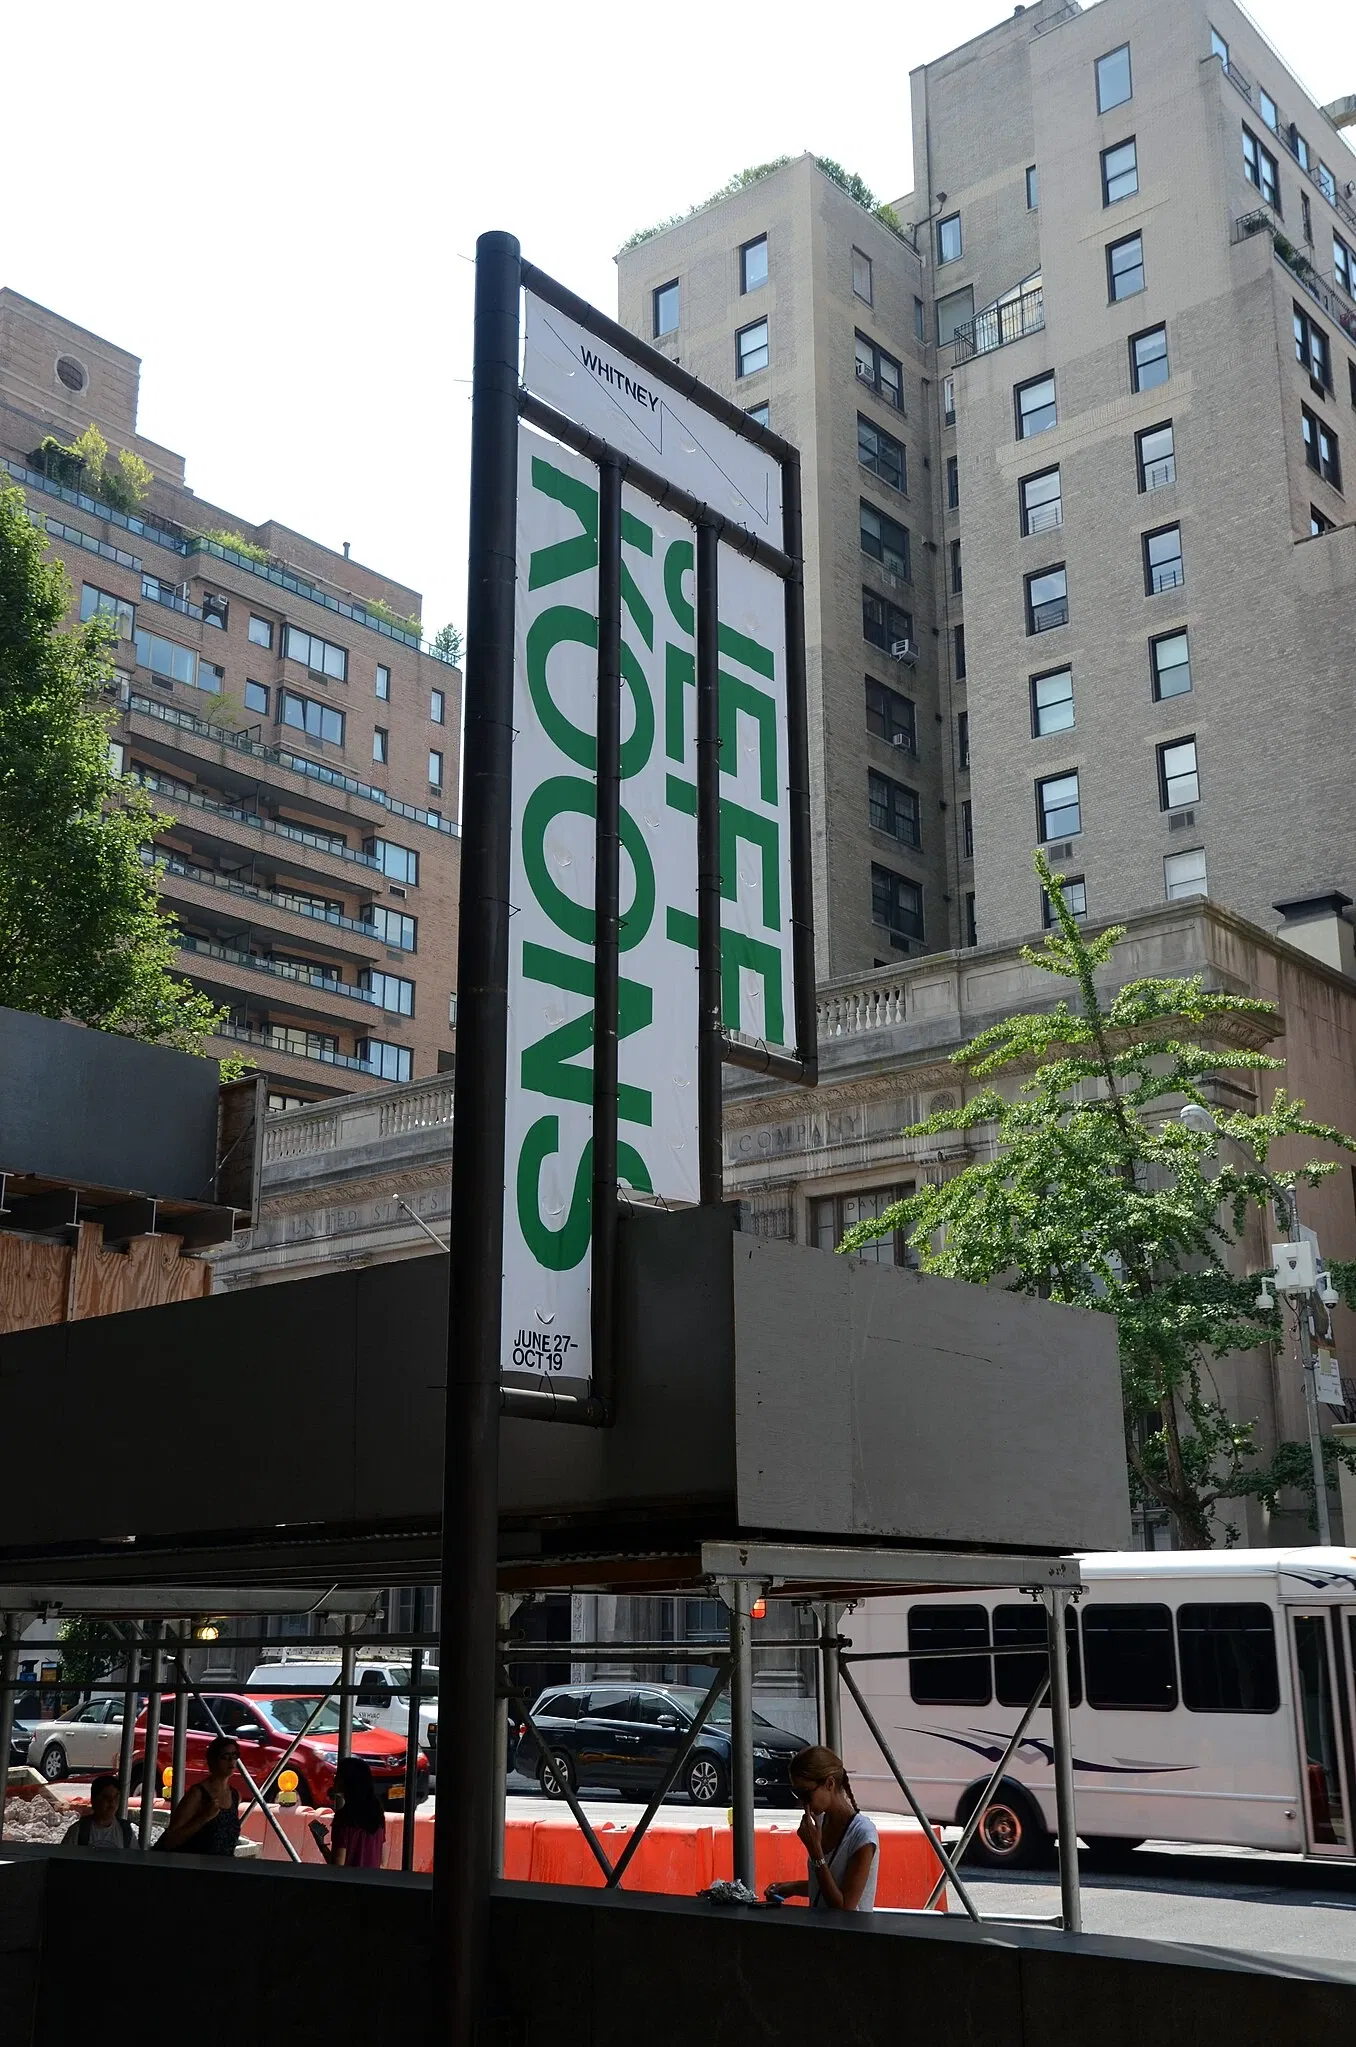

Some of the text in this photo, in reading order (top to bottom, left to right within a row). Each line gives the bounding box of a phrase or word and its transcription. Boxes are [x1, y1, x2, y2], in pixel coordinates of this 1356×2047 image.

[580, 345, 659, 412] WHITNEY
[664, 540, 784, 1047] JEFF
[517, 455, 656, 1272] KOONS
[739, 1113, 859, 1152] COMPANY
[292, 1210, 357, 1235] UNITED
[512, 1348, 563, 1371] OCT 19
[514, 1329, 578, 1352] JUNE 27-
